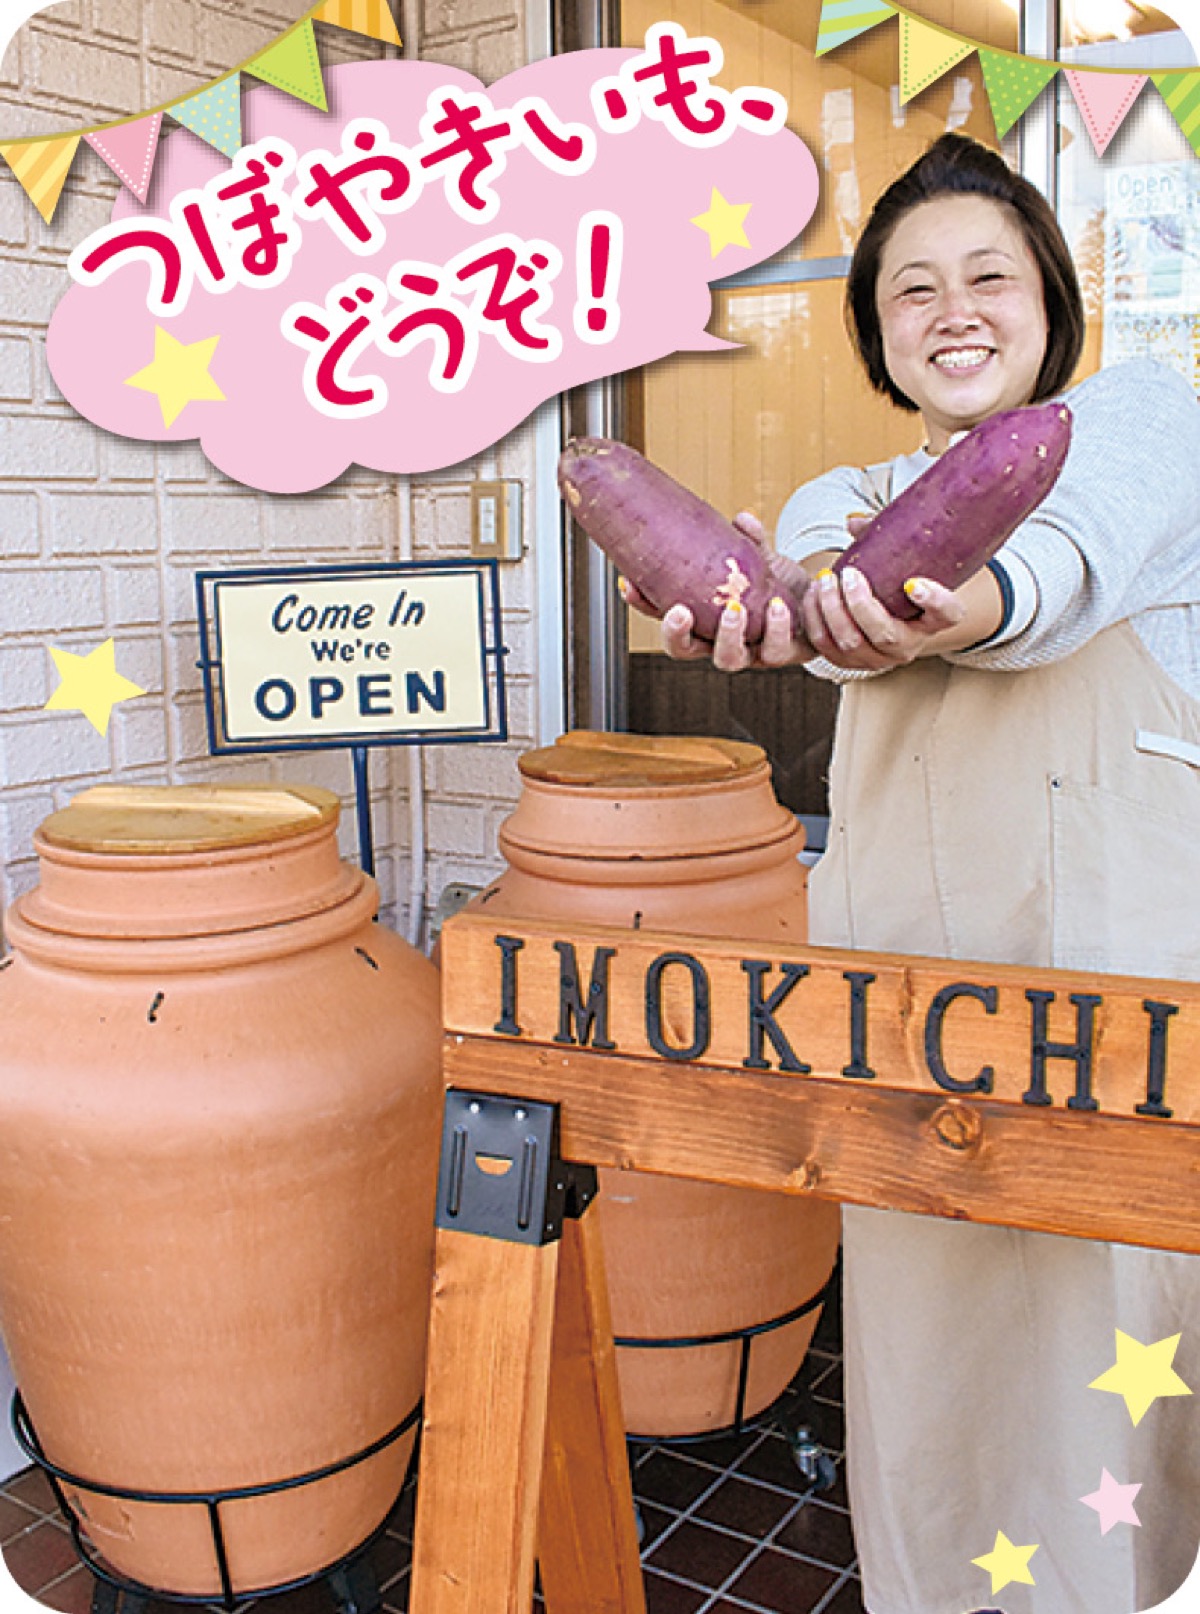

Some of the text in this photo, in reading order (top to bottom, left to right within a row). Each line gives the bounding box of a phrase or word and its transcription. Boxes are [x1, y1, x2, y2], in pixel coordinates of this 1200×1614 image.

[1117, 173, 1172, 198] Open
[271, 589, 426, 633] Come In
[311, 638, 392, 662] We're
[254, 670, 447, 722] OPEN
[493, 934, 1180, 1119] IMOKICHI
